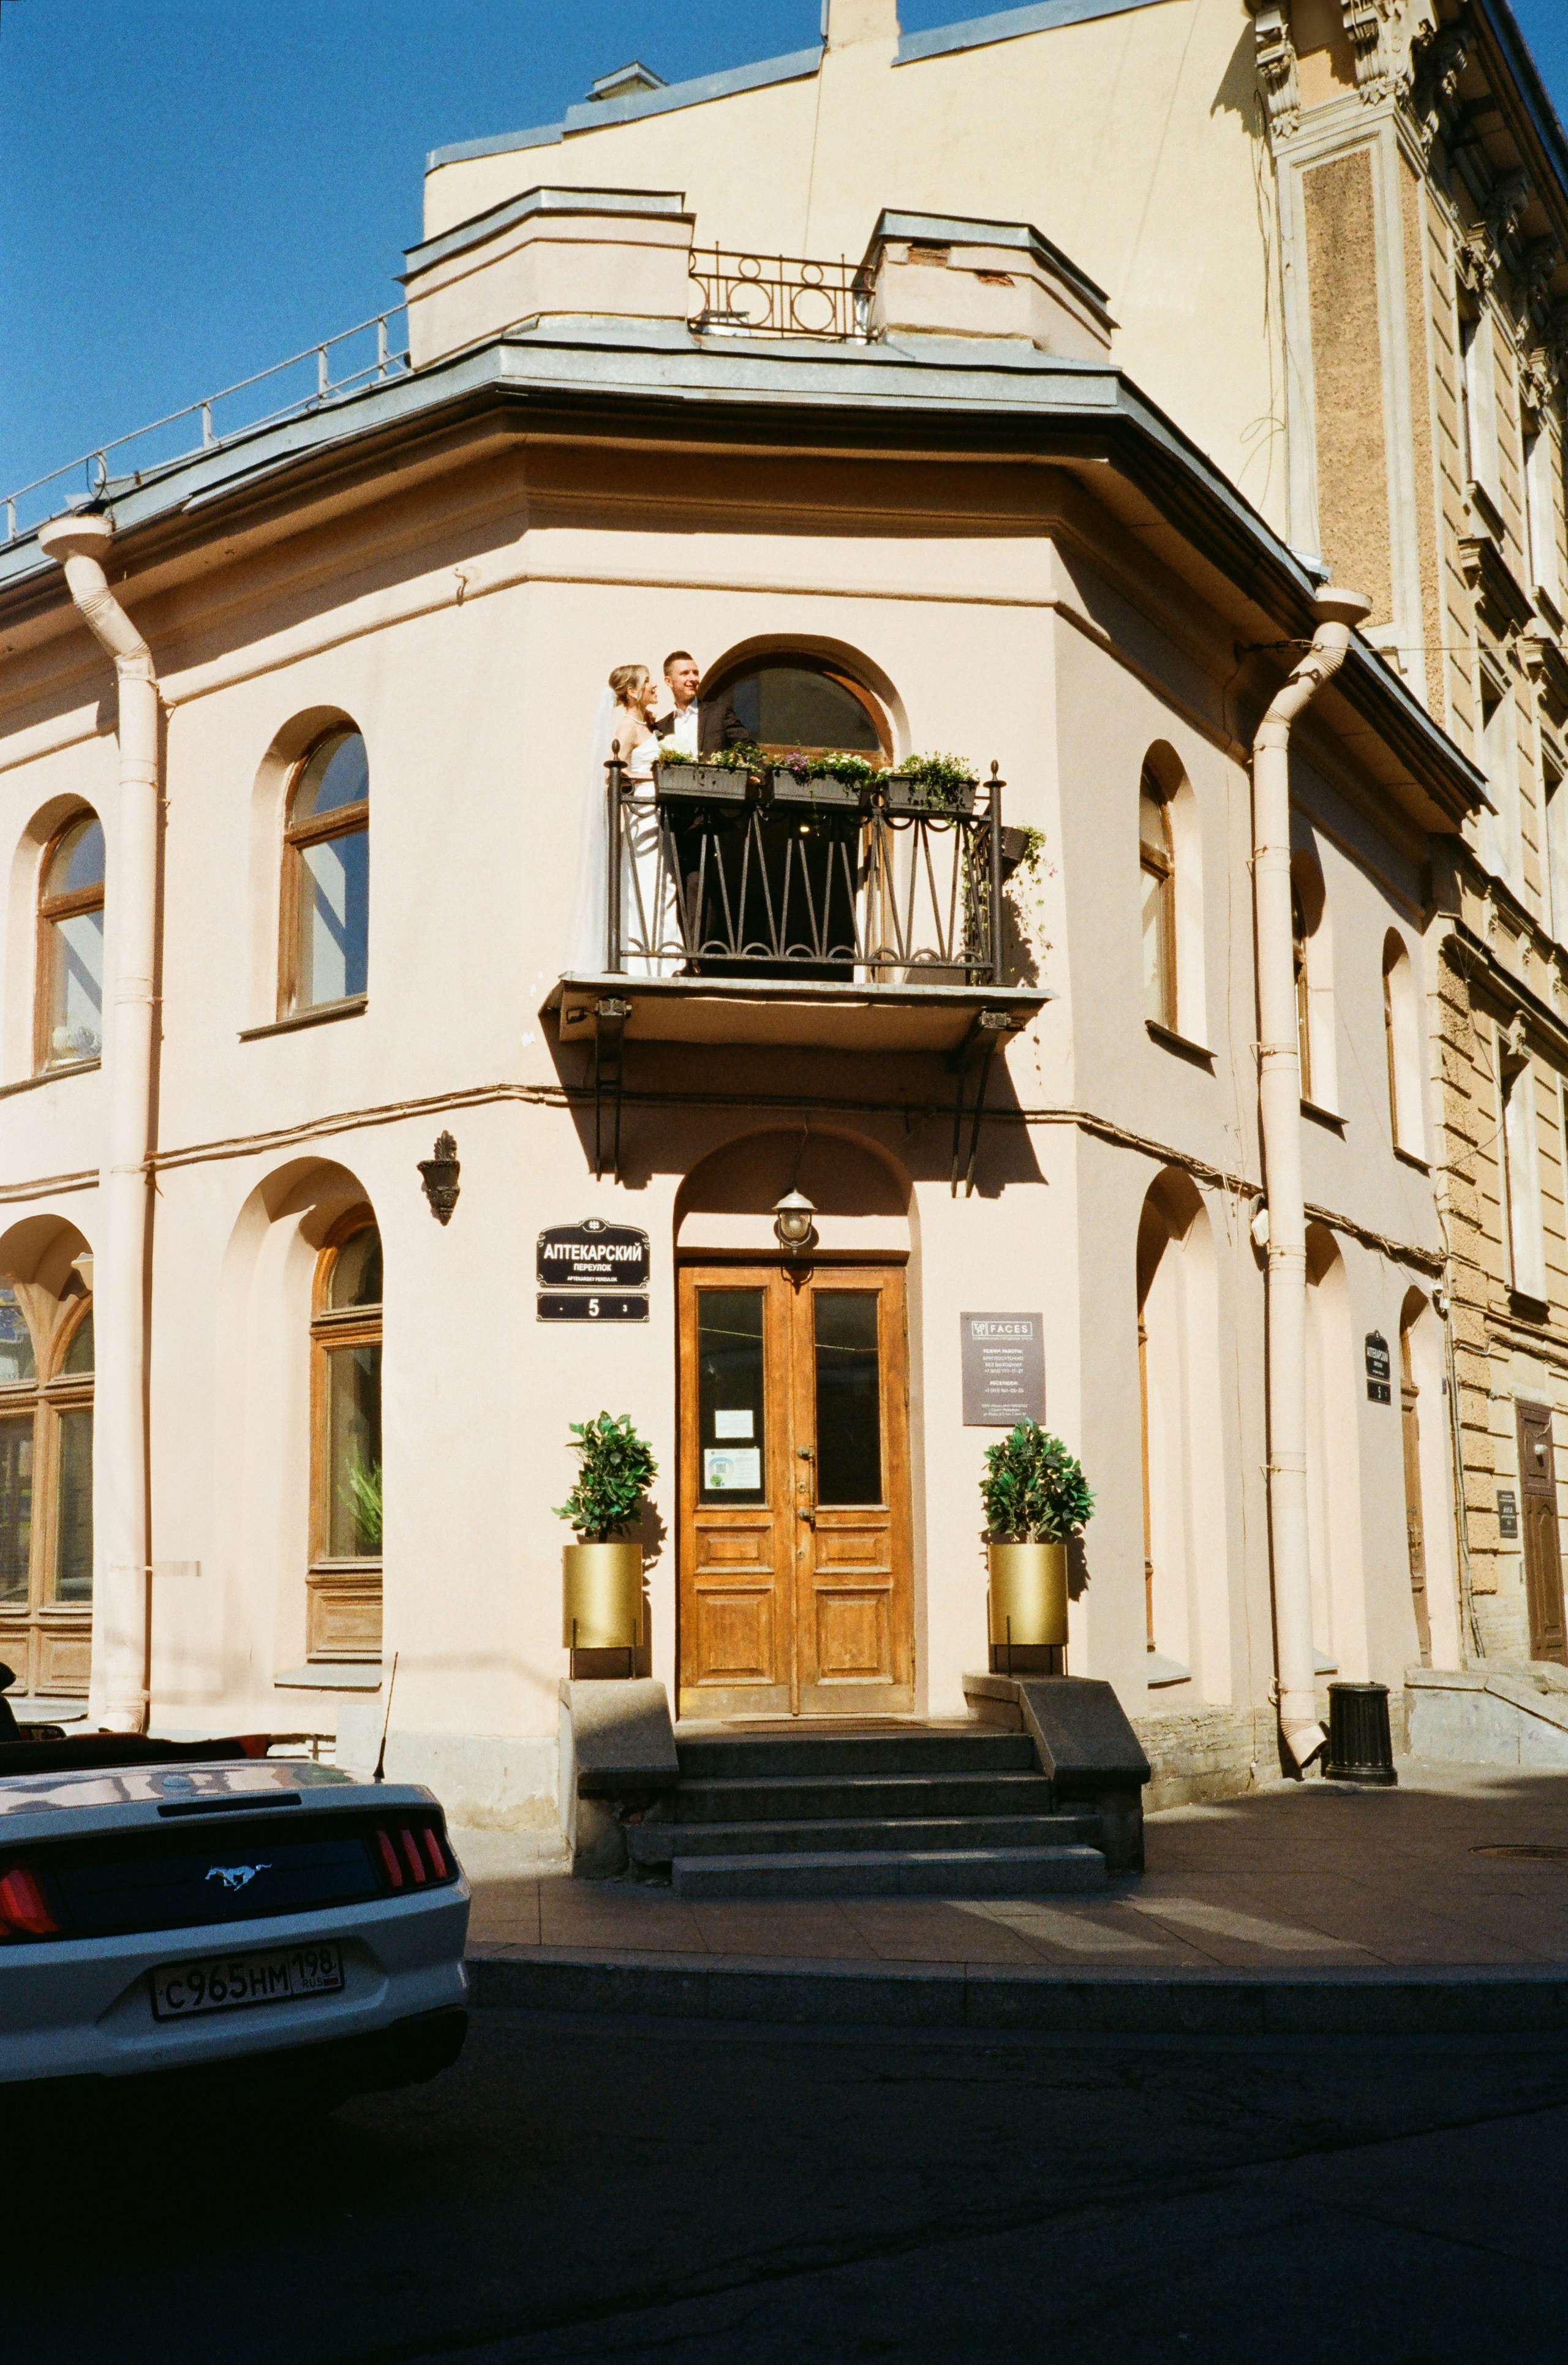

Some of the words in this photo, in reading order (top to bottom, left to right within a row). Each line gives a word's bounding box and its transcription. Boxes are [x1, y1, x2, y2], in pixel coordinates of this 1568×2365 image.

[543, 1242, 642, 1261] АПТЕКАРСКИЙ
[573, 1263, 612, 1272] ПЕРЕУЛОК
[589, 1299, 600, 1316] 5
[990, 1324, 1028, 1333] FACES
[291, 1948, 334, 1978] 198
[302, 1977, 323, 1988] RUS
